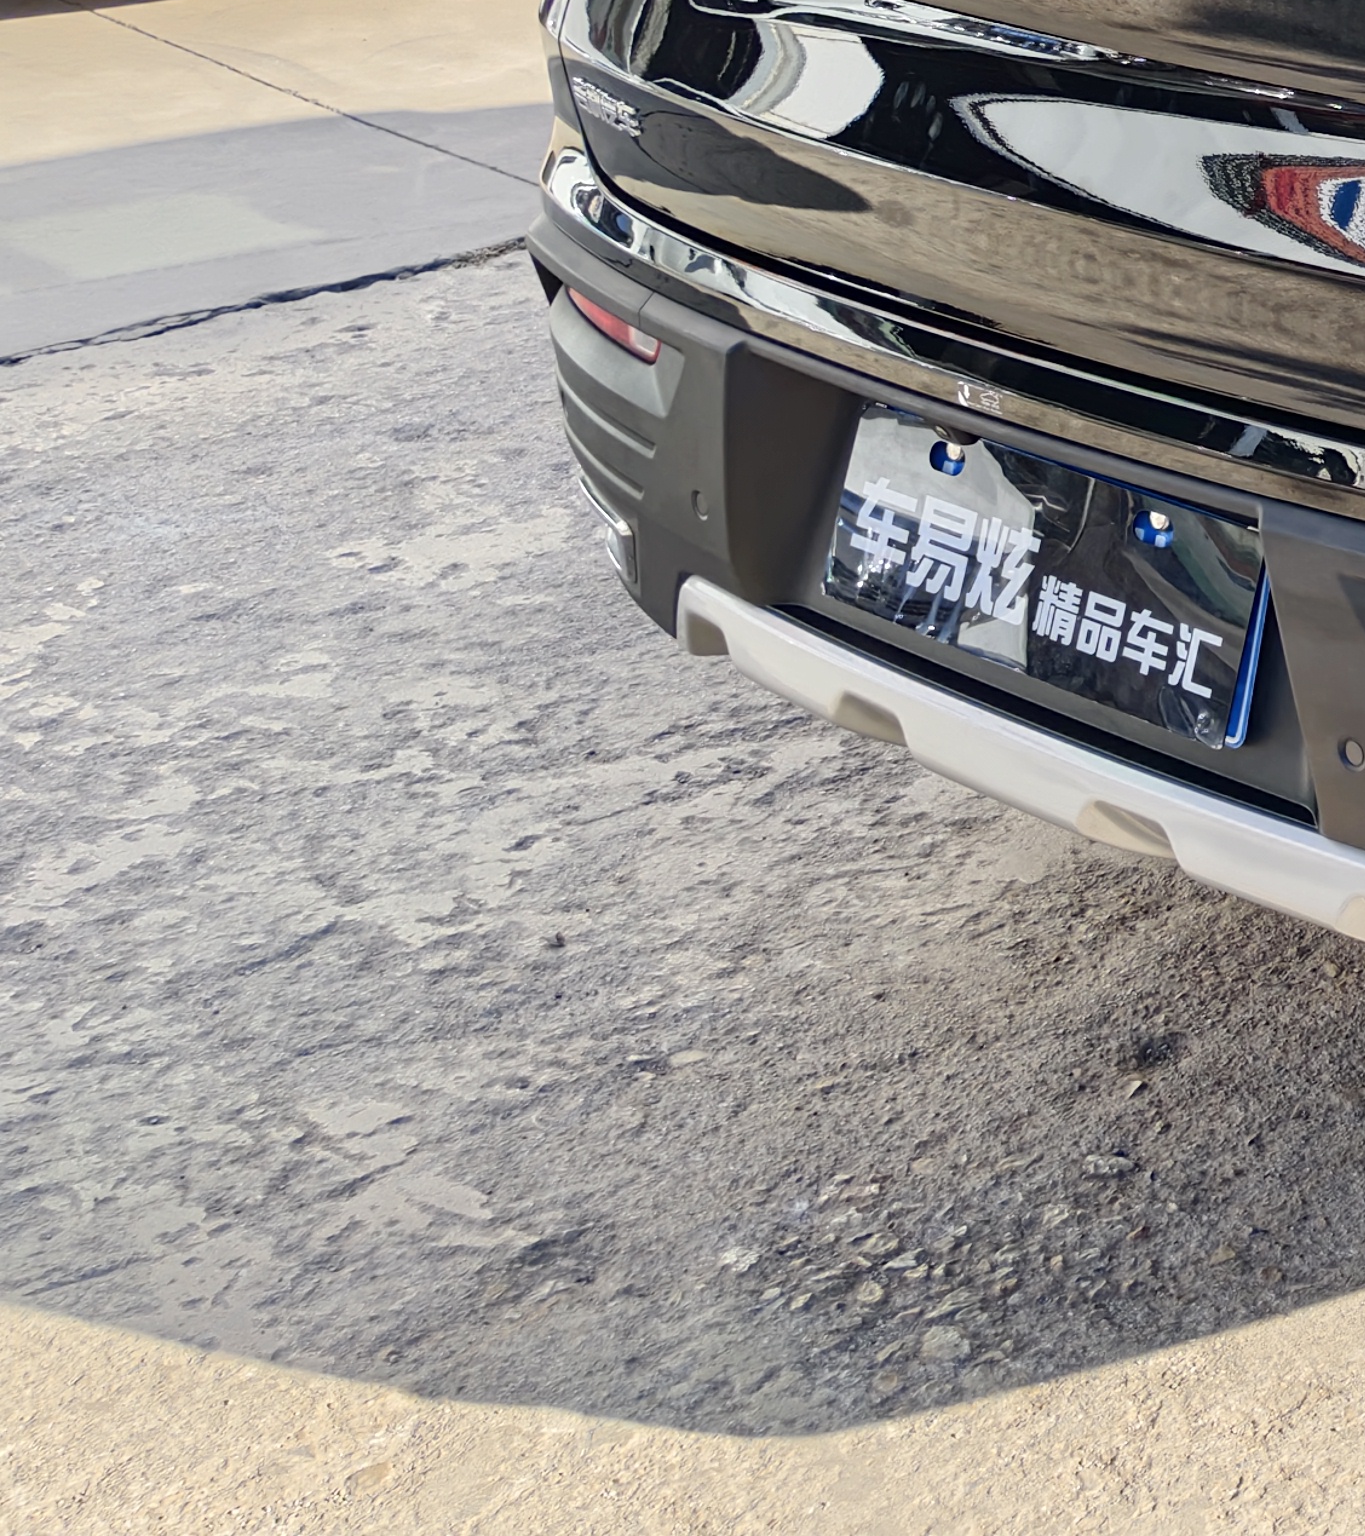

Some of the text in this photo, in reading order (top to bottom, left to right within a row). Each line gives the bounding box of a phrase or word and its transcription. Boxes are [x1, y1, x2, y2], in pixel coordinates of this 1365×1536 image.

[850, 477, 1224, 699] 车易炫 精品车汇
